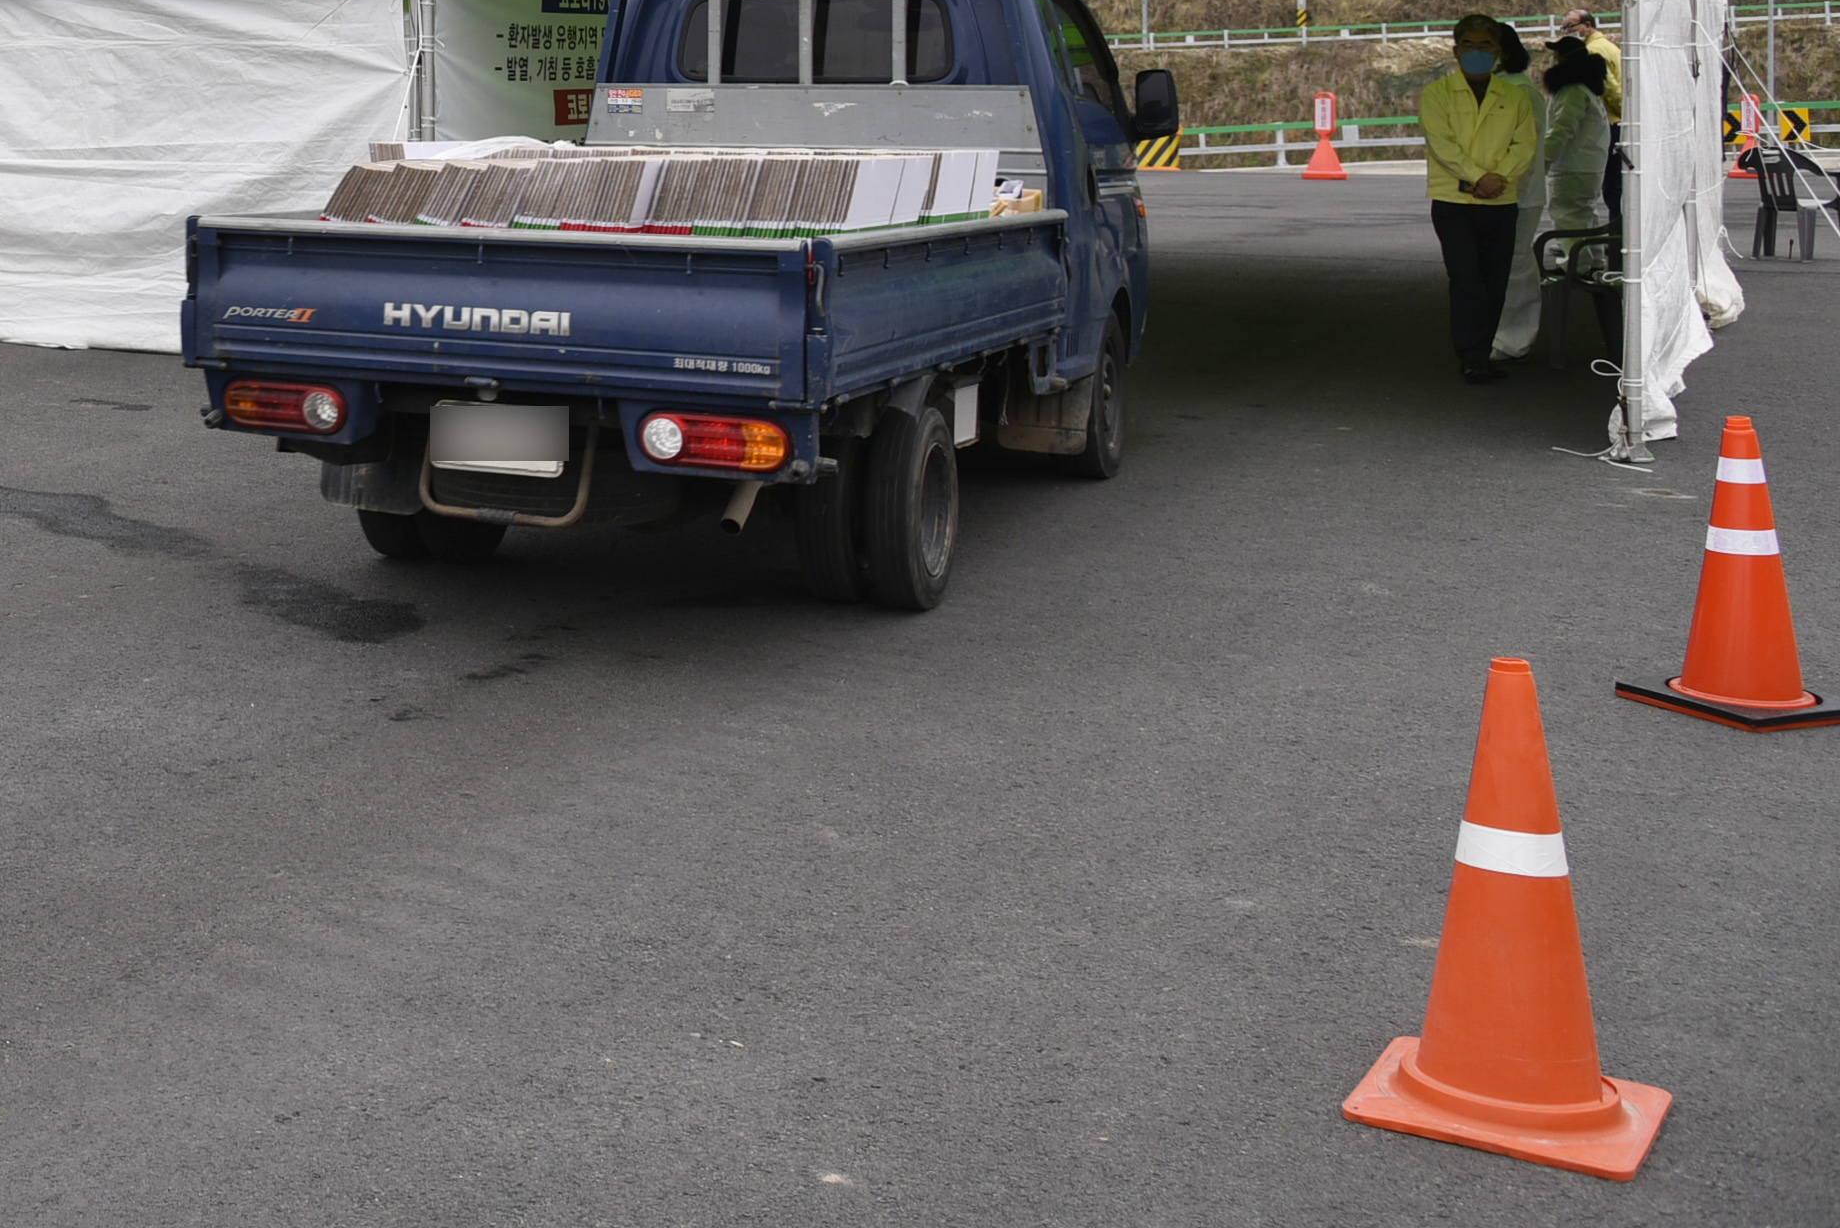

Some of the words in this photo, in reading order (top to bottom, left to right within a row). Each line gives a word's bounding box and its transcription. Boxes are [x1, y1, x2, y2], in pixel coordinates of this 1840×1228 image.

[507, 23, 553, 50] 환자발생
[556, 25, 598, 50] 유행지역
[537, 56, 558, 81] 기침
[561, 57, 572, 81] 등
[383, 302, 572, 337] HYUNDAI
[673, 357, 728, 372] 최대적재량
[731, 361, 771, 375] 1000kg
